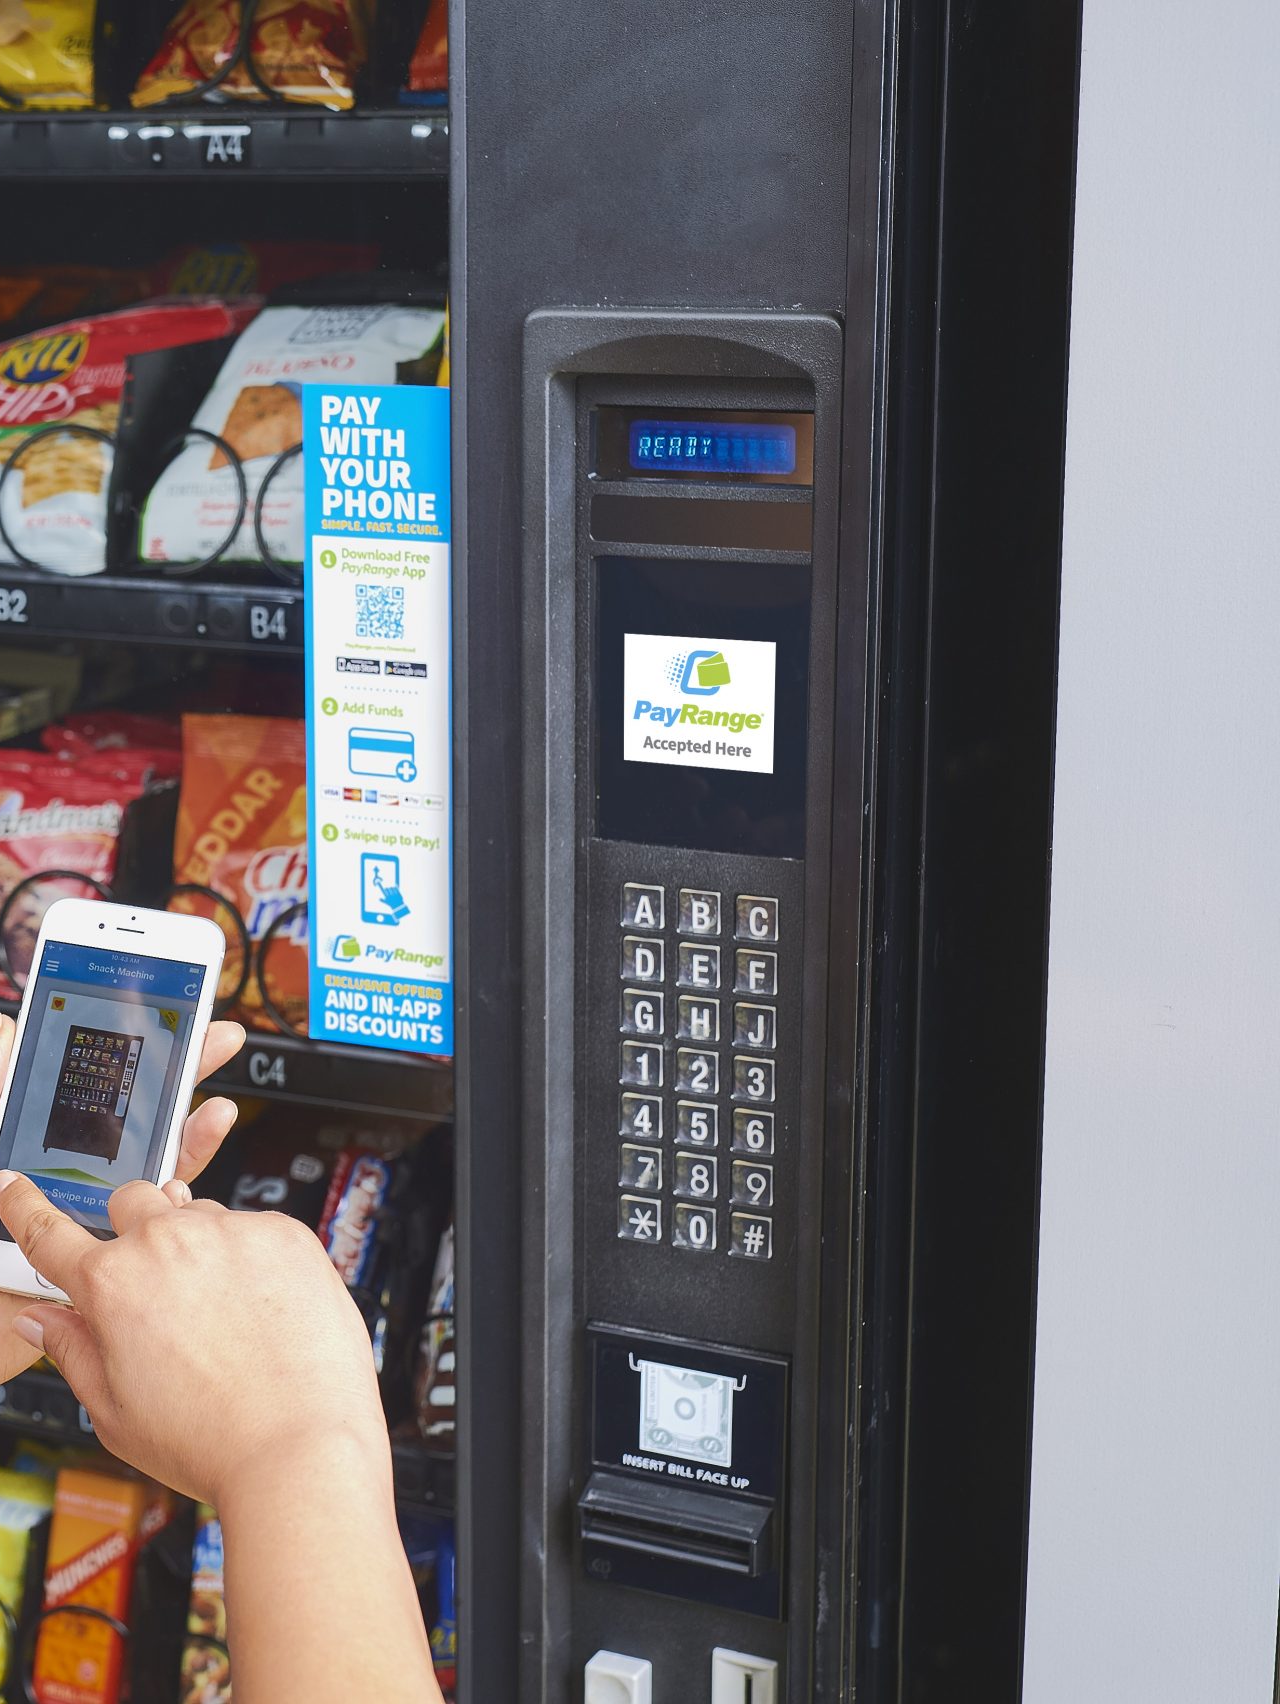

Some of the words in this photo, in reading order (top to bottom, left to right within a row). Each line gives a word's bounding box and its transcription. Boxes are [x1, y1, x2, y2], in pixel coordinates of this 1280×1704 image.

[206, 133, 242, 163] A4
[321, 395, 381, 425] PAY
[320, 427, 405, 458] WITH
[638, 436, 712, 457] READY
[320, 457, 411, 489] YOUR
[322, 488, 436, 521] PHONE
[321, 519, 364, 531] SIMPLE.
[366, 521, 394, 533] FAST.
[397, 523, 442, 535] SECURE.
[341, 548, 401, 562] Download
[404, 551, 430, 564] Free
[341, 562, 400, 579] PayRange
[402, 566, 426, 580] App
[251, 606, 287, 640] B4
[342, 702, 365, 714] Add
[368, 704, 404, 717] Funds
[632, 700, 762, 734] PayRange
[643, 736, 711, 755] Accepted
[715, 742, 752, 757] Here
[344, 829, 379, 844] Swipe
[382, 832, 397, 846] up
[400, 834, 411, 846] to
[414, 836, 440, 851] Pay!
[634, 895, 655, 926] A
[692, 901, 711, 930] B
[749, 907, 769, 936] C
[88, 962, 115, 975] Snack
[117, 966, 155, 981] Machine
[365, 944, 444, 968] PayRange
[635, 948, 655, 977] D
[692, 954, 709, 984] E
[749, 960, 766, 990] F
[325, 974, 391, 994] EXCLUSIVE
[393, 983, 443, 1000] OFFERS
[325, 989, 368, 1012] AND
[372, 995, 442, 1021] IN-APP
[325, 1011, 444, 1044] DISCOUNTS
[634, 1001, 654, 1031] G
[691, 1007, 710, 1038] H
[748, 1014, 765, 1044] J
[249, 1052, 287, 1088] C4
[636, 1053, 649, 1081] 1
[691, 1059, 709, 1089] 2
[747, 1067, 765, 1097] 3
[634, 1105, 652, 1133] 4
[690, 1112, 708, 1141] 5
[746, 1120, 764, 1149] 6
[638, 1156, 654, 1186] 7
[690, 1164, 709, 1194] 8
[746, 1173, 766, 1202] 9
[52, 1188, 81, 1202] Swipe
[83, 1196, 96, 1207] up
[689, 1215, 707, 1244] 0
[743, 1225, 765, 1253] #
[622, 1453, 666, 1473] INSERT
[668, 1463, 694, 1480] BILL
[696, 1469, 728, 1487] FACE
[731, 1477, 750, 1490] UP
